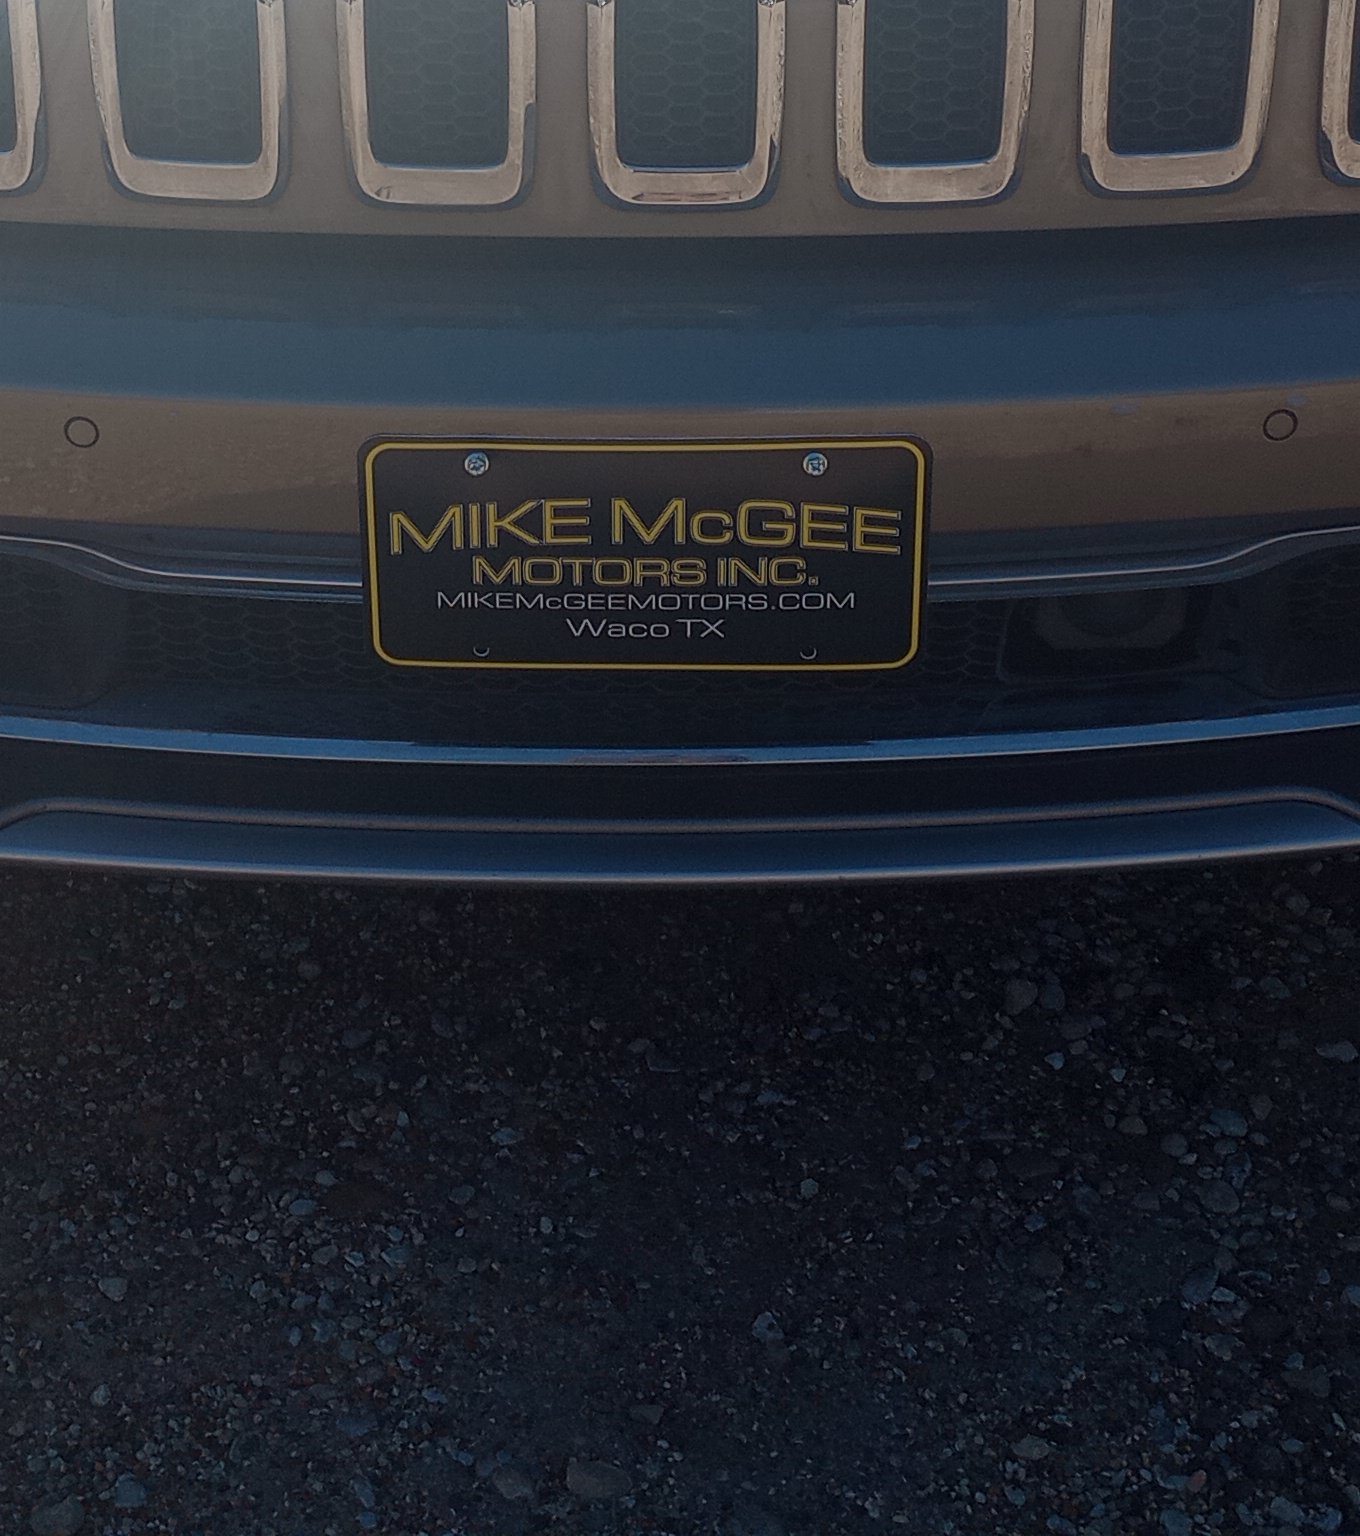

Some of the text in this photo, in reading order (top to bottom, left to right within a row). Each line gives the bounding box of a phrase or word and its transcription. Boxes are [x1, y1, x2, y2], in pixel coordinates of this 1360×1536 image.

[390, 498, 902, 556] MIKE McGEE
[472, 556, 819, 587] MOTORS INC.
[437, 591, 855, 611] MIKEMcGEEMOTORS.COM
[566, 618, 725, 638] Waco TX
